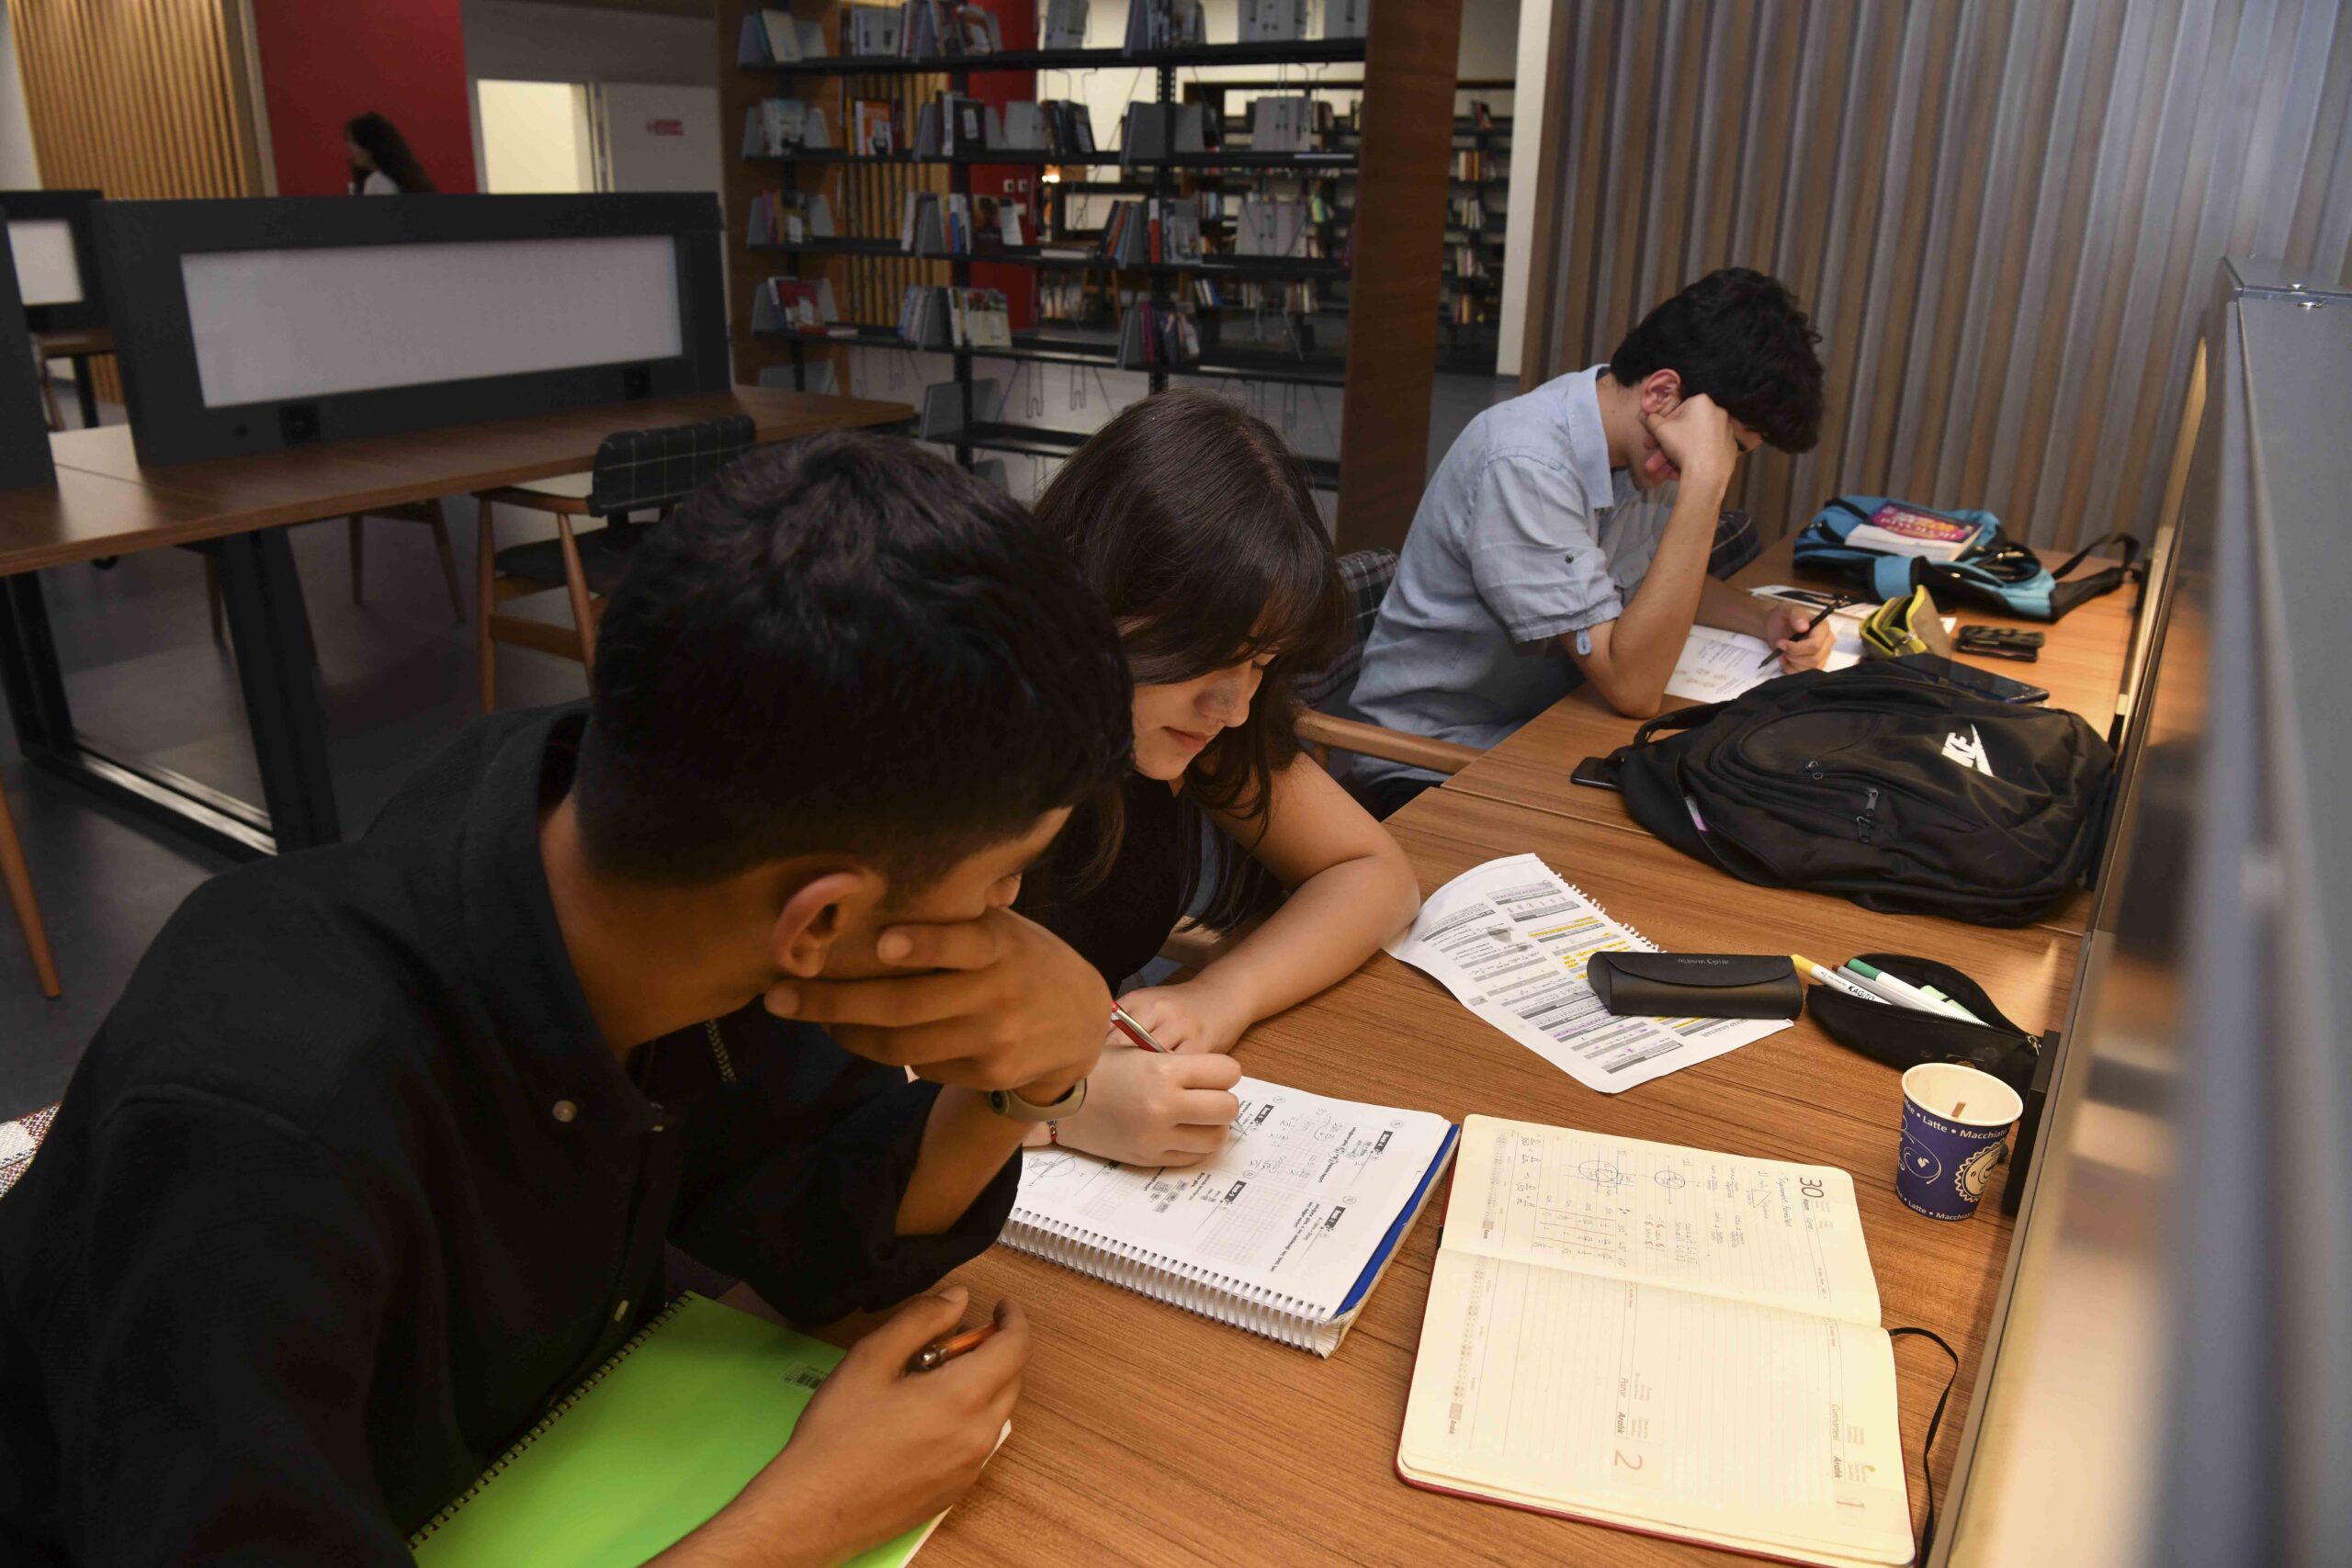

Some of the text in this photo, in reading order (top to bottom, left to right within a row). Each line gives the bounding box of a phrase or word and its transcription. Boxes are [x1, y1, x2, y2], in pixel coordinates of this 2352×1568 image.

[1923, 1115, 1948, 1133] Latte
[1800, 1177, 1825, 1198] 30
[1908, 1200, 1927, 1214] Latte
[1615, 1411, 1626, 1435] Aralık
[1614, 1450, 1644, 1471] 2
[1831, 1404, 1867, 1509] Cumartesi Aralık 1
